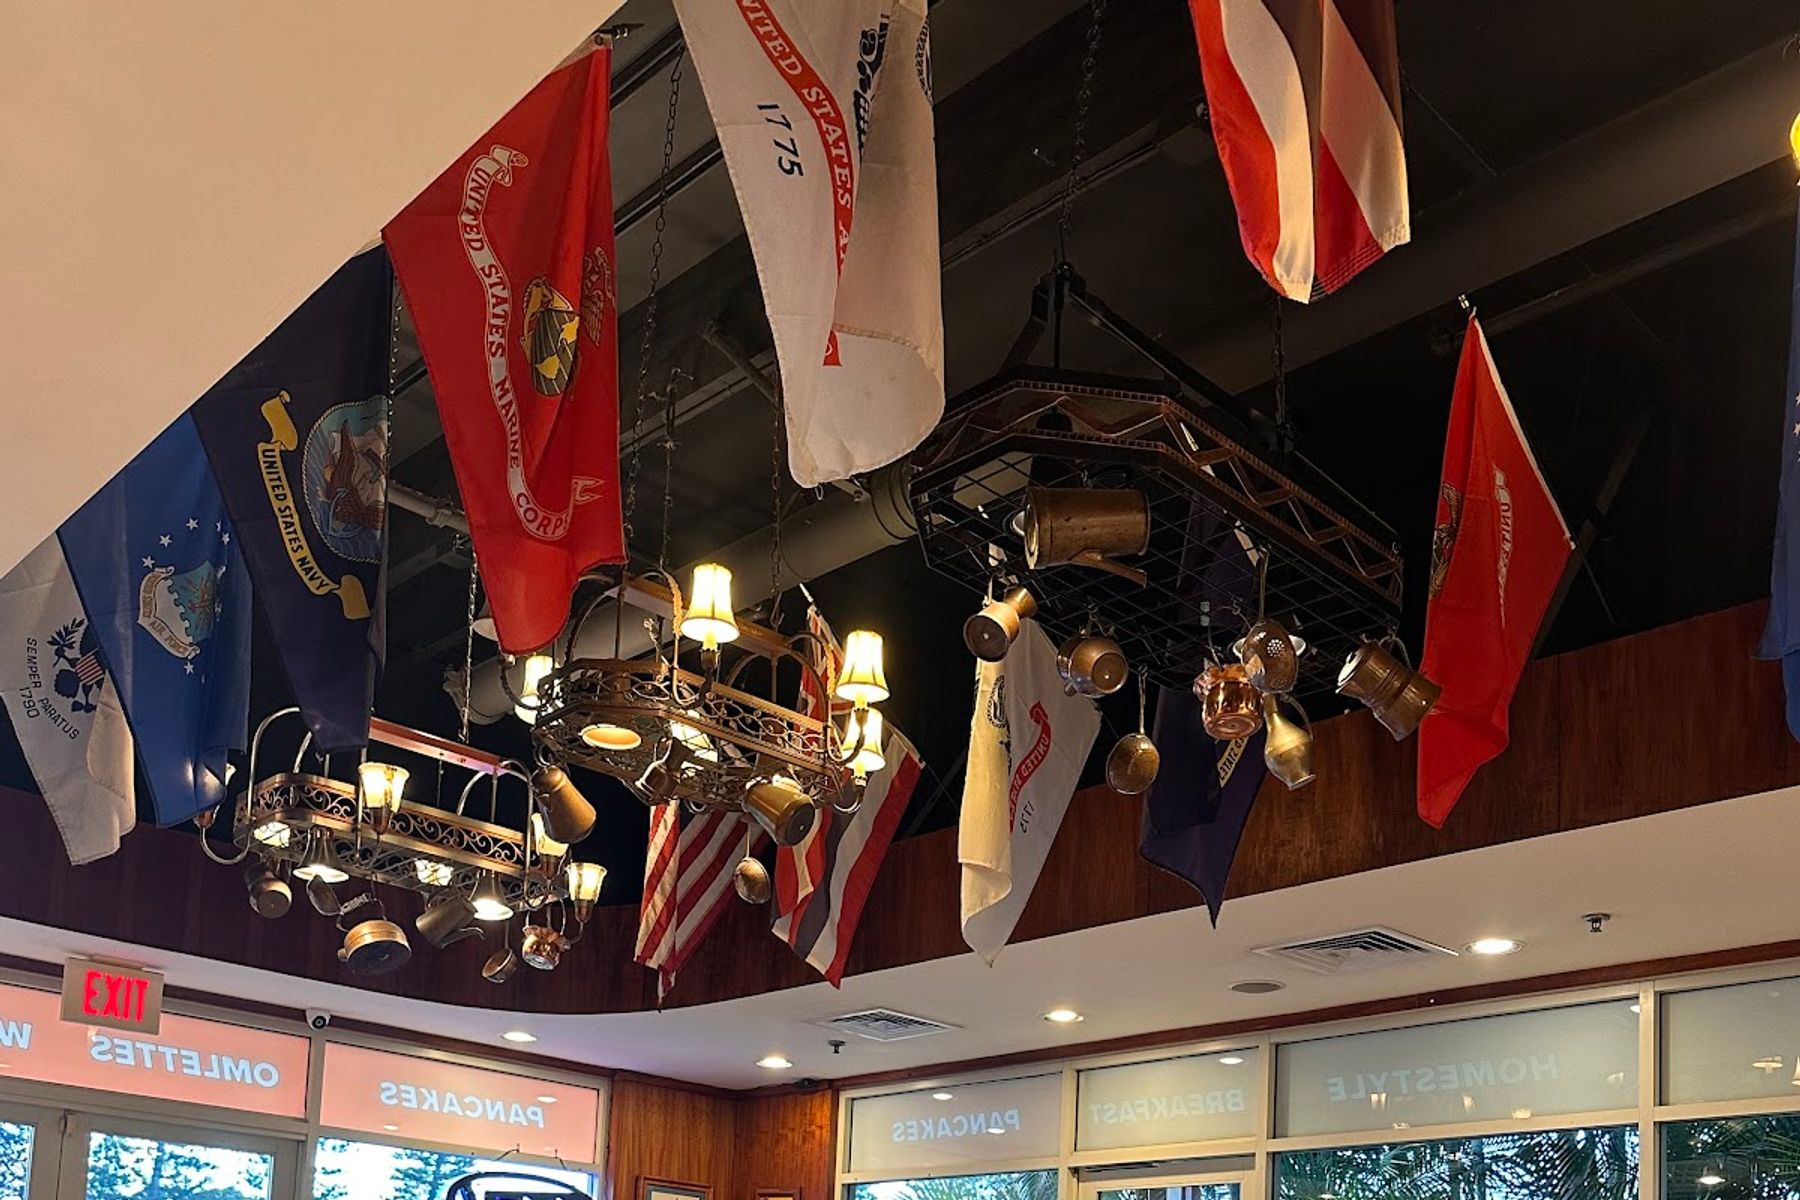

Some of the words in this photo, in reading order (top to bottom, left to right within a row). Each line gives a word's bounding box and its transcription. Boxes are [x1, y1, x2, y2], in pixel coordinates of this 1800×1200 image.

[757, 103, 804, 177] 1775
[802, 86, 852, 209] STATES
[462, 166, 491, 251] UNITED
[480, 263, 510, 358] STATES
[495, 375, 520, 469] MARINE
[262, 448, 287, 502] UNITED
[277, 505, 305, 555] STATES
[296, 556, 330, 591] NAVY
[19, 686, 40, 719] 1790
[26, 637, 42, 689] SEMPER
[37, 697, 80, 740] PARATUS
[83, 969, 149, 1023] EXIT
